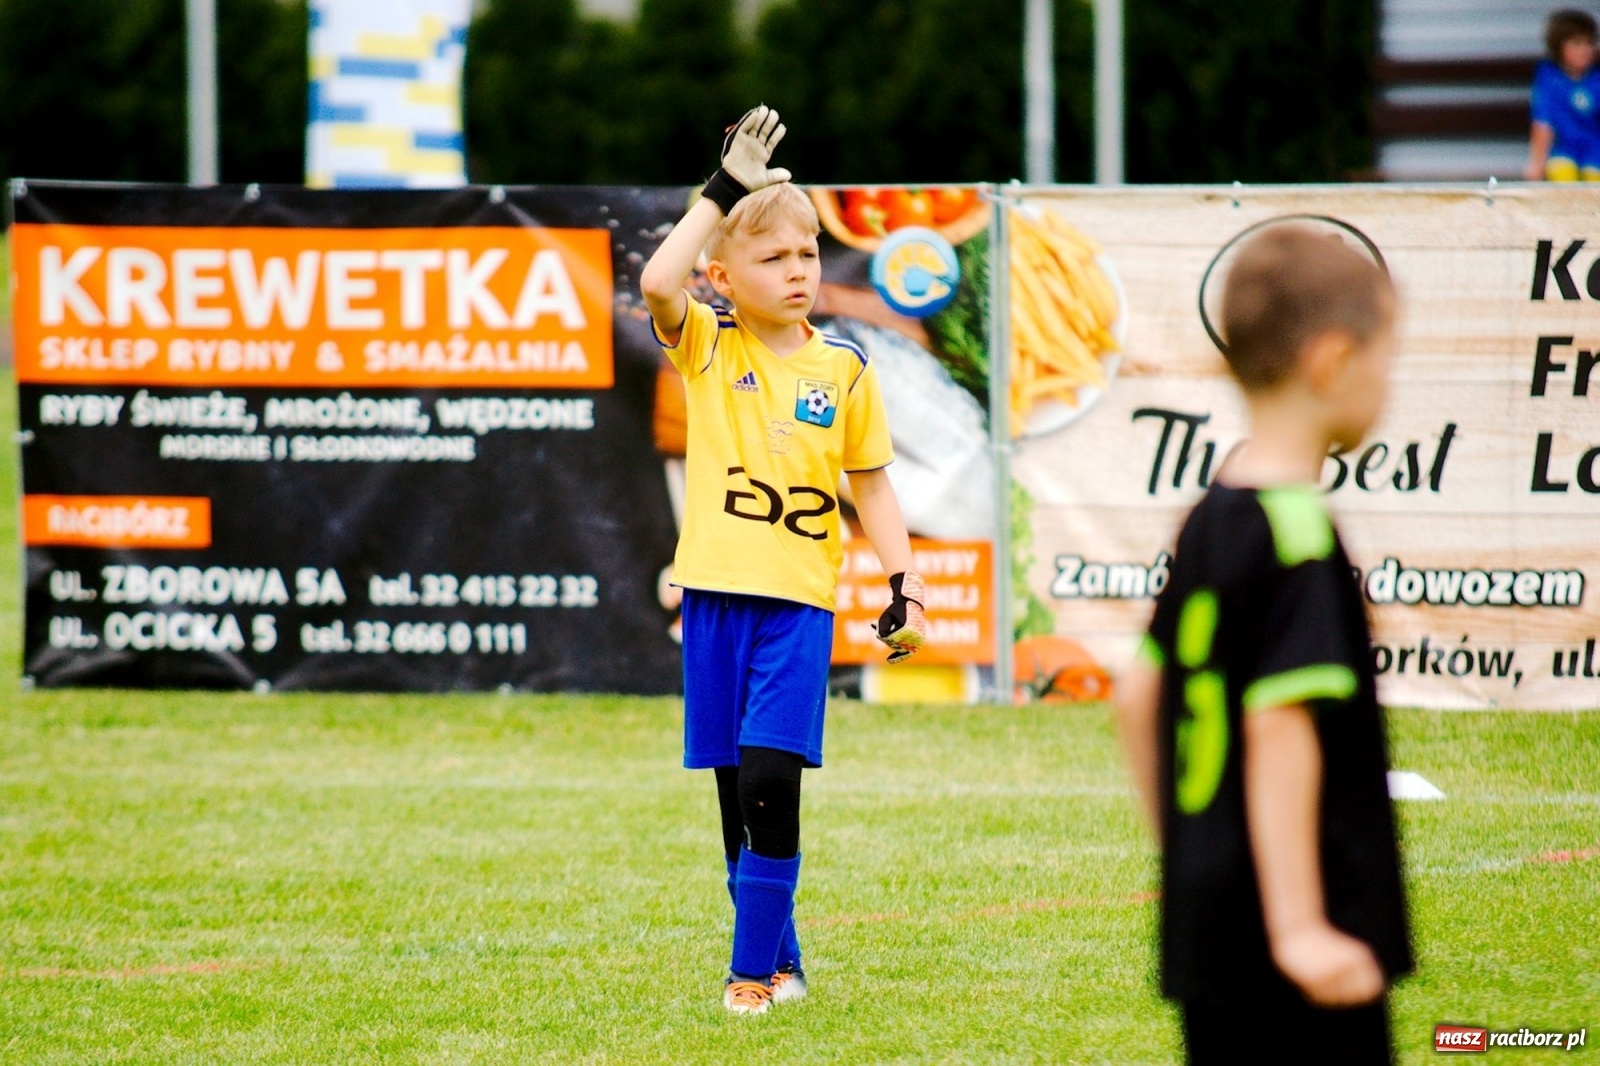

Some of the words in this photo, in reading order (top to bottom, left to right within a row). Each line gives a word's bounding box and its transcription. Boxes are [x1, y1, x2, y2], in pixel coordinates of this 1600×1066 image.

[38, 246, 588, 330] KREWETKA
[39, 336, 157, 370] SKLEP
[168, 338, 295, 372] RYBNY
[316, 341, 344, 373] &
[364, 335, 589, 373] SMAŻALNIA
[731, 383, 759, 393] adidas
[39, 394, 126, 427] RYBY
[130, 389, 259, 434] ŚWIEŻE,
[263, 391, 432, 434] MROŻONE,
[434, 397, 595, 436] WĘDZONE
[159, 433, 272, 462] MORSKIE
[289, 434, 477, 463] SŁODKOWODNE
[1132, 407, 1216, 496] Th
[47, 498, 191, 540] RACIBÓRZ
[101, 565, 290, 606] ZBOROWA
[295, 567, 347, 606] 5A
[1051, 552, 1171, 599] Zamó
[1366, 556, 1586, 608] dowozem
[103, 611, 246, 651] OCICKA
[251, 613, 278, 652] 5
[1371, 634, 1524, 689] orków,
